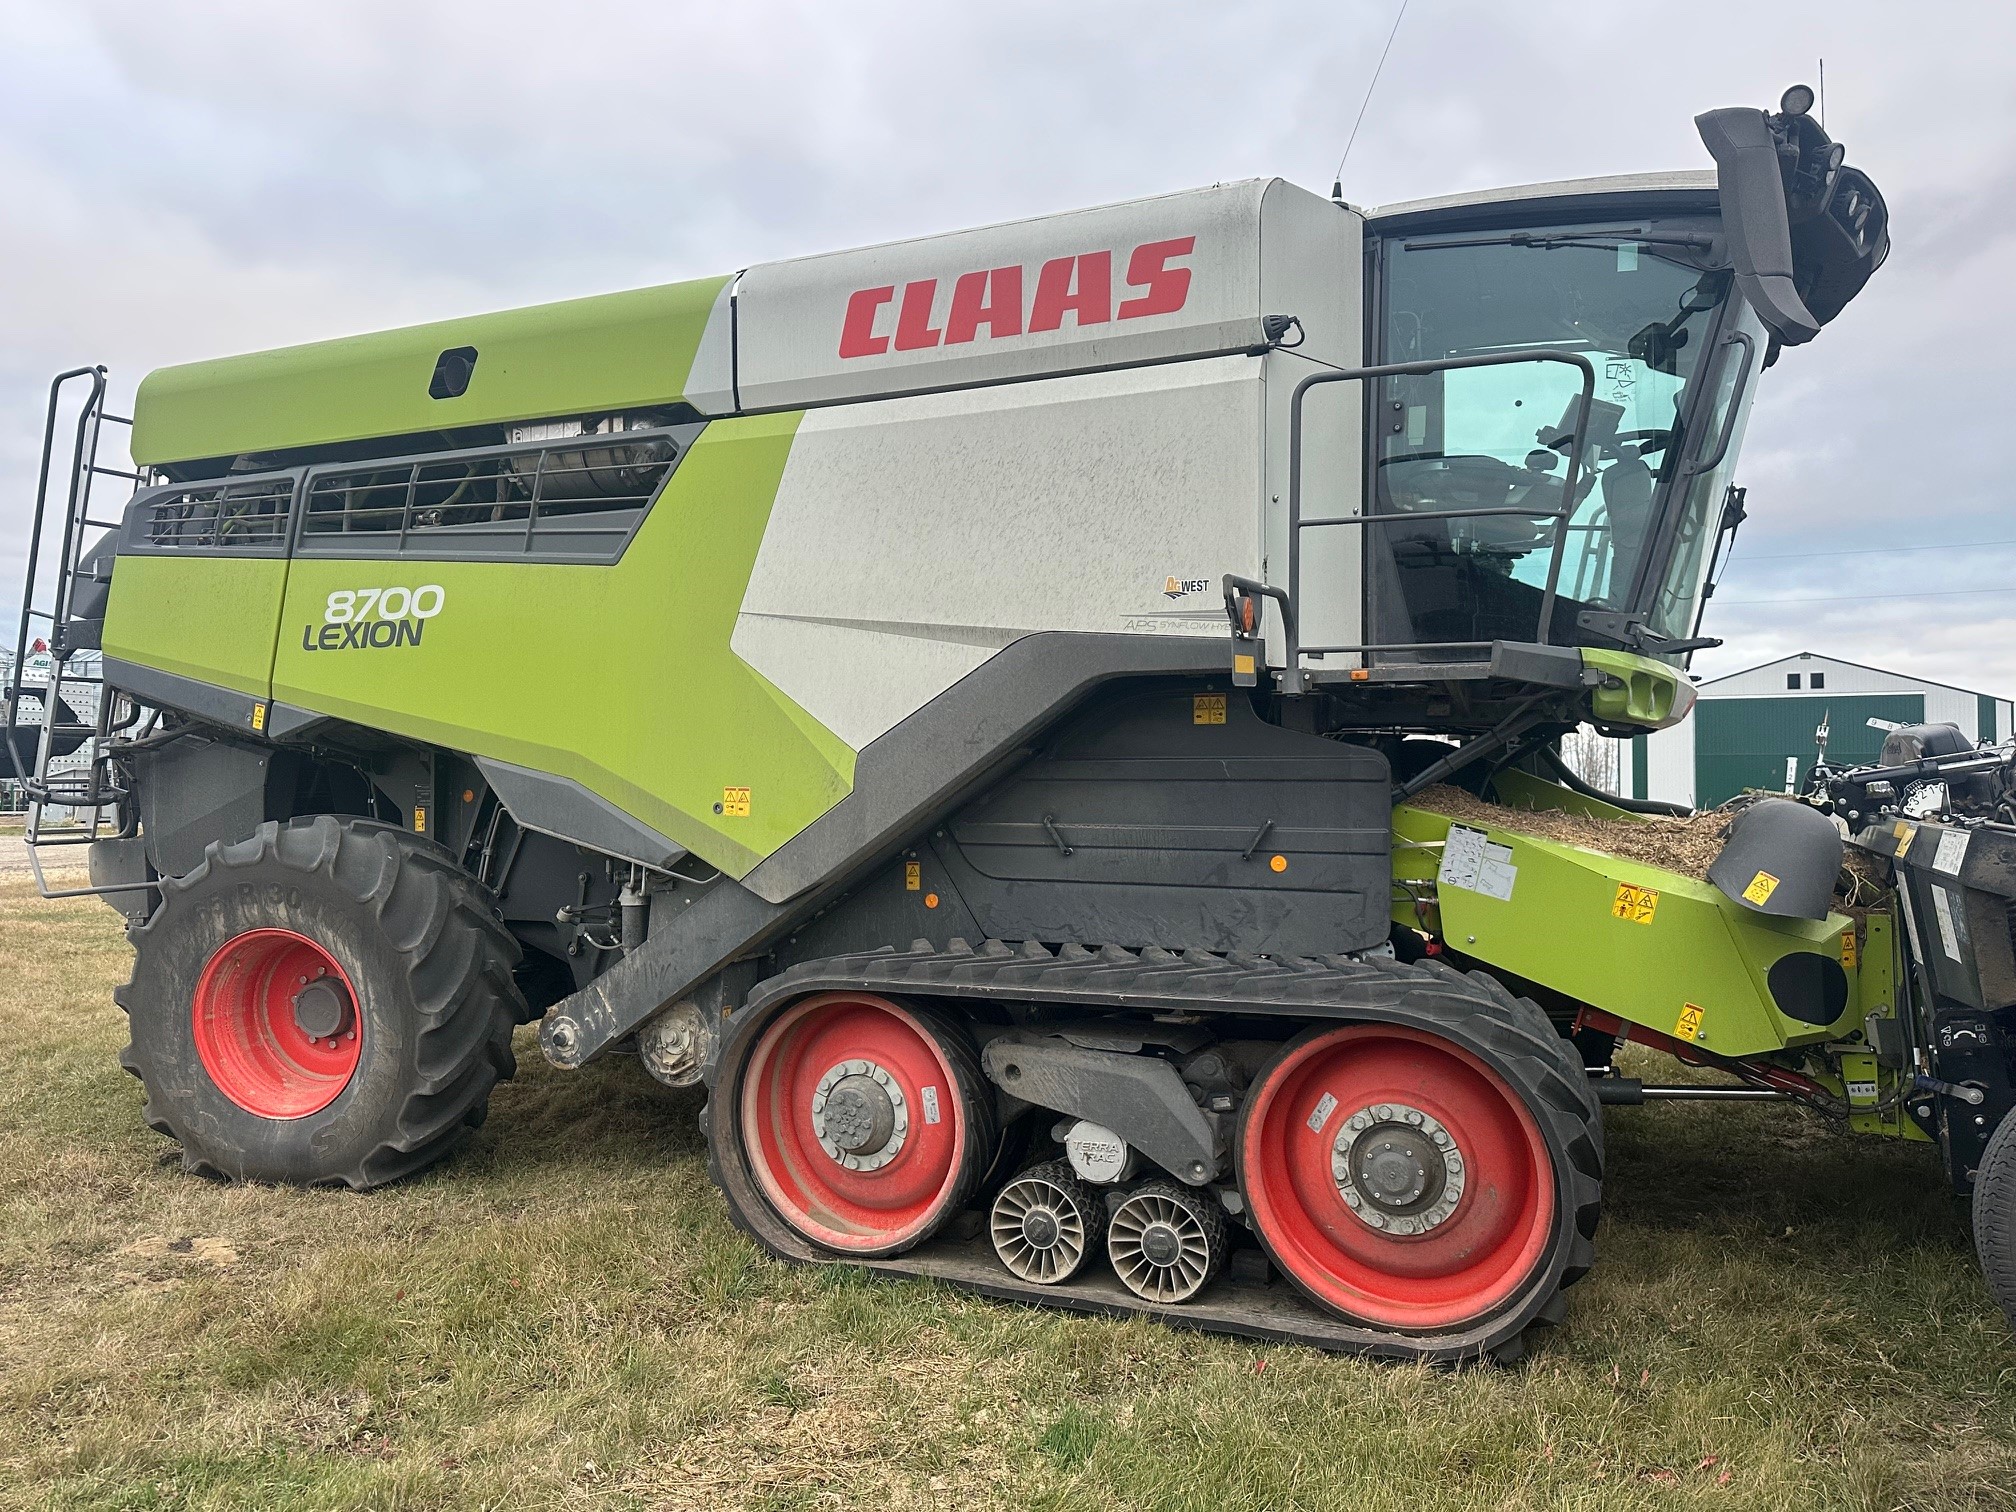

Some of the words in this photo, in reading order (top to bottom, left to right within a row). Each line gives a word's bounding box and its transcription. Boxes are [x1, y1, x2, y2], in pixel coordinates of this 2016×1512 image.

[839, 235, 1196, 359] CLAAS
[324, 584, 445, 624] 8700
[302, 618, 424, 651] LEXION
[1123, 619, 1159, 632] APS
[1159, 621, 1211, 630] SYNFLOW
[1074, 1140, 1119, 1153] TERRA
[1080, 1151, 1115, 1163] TRAC
